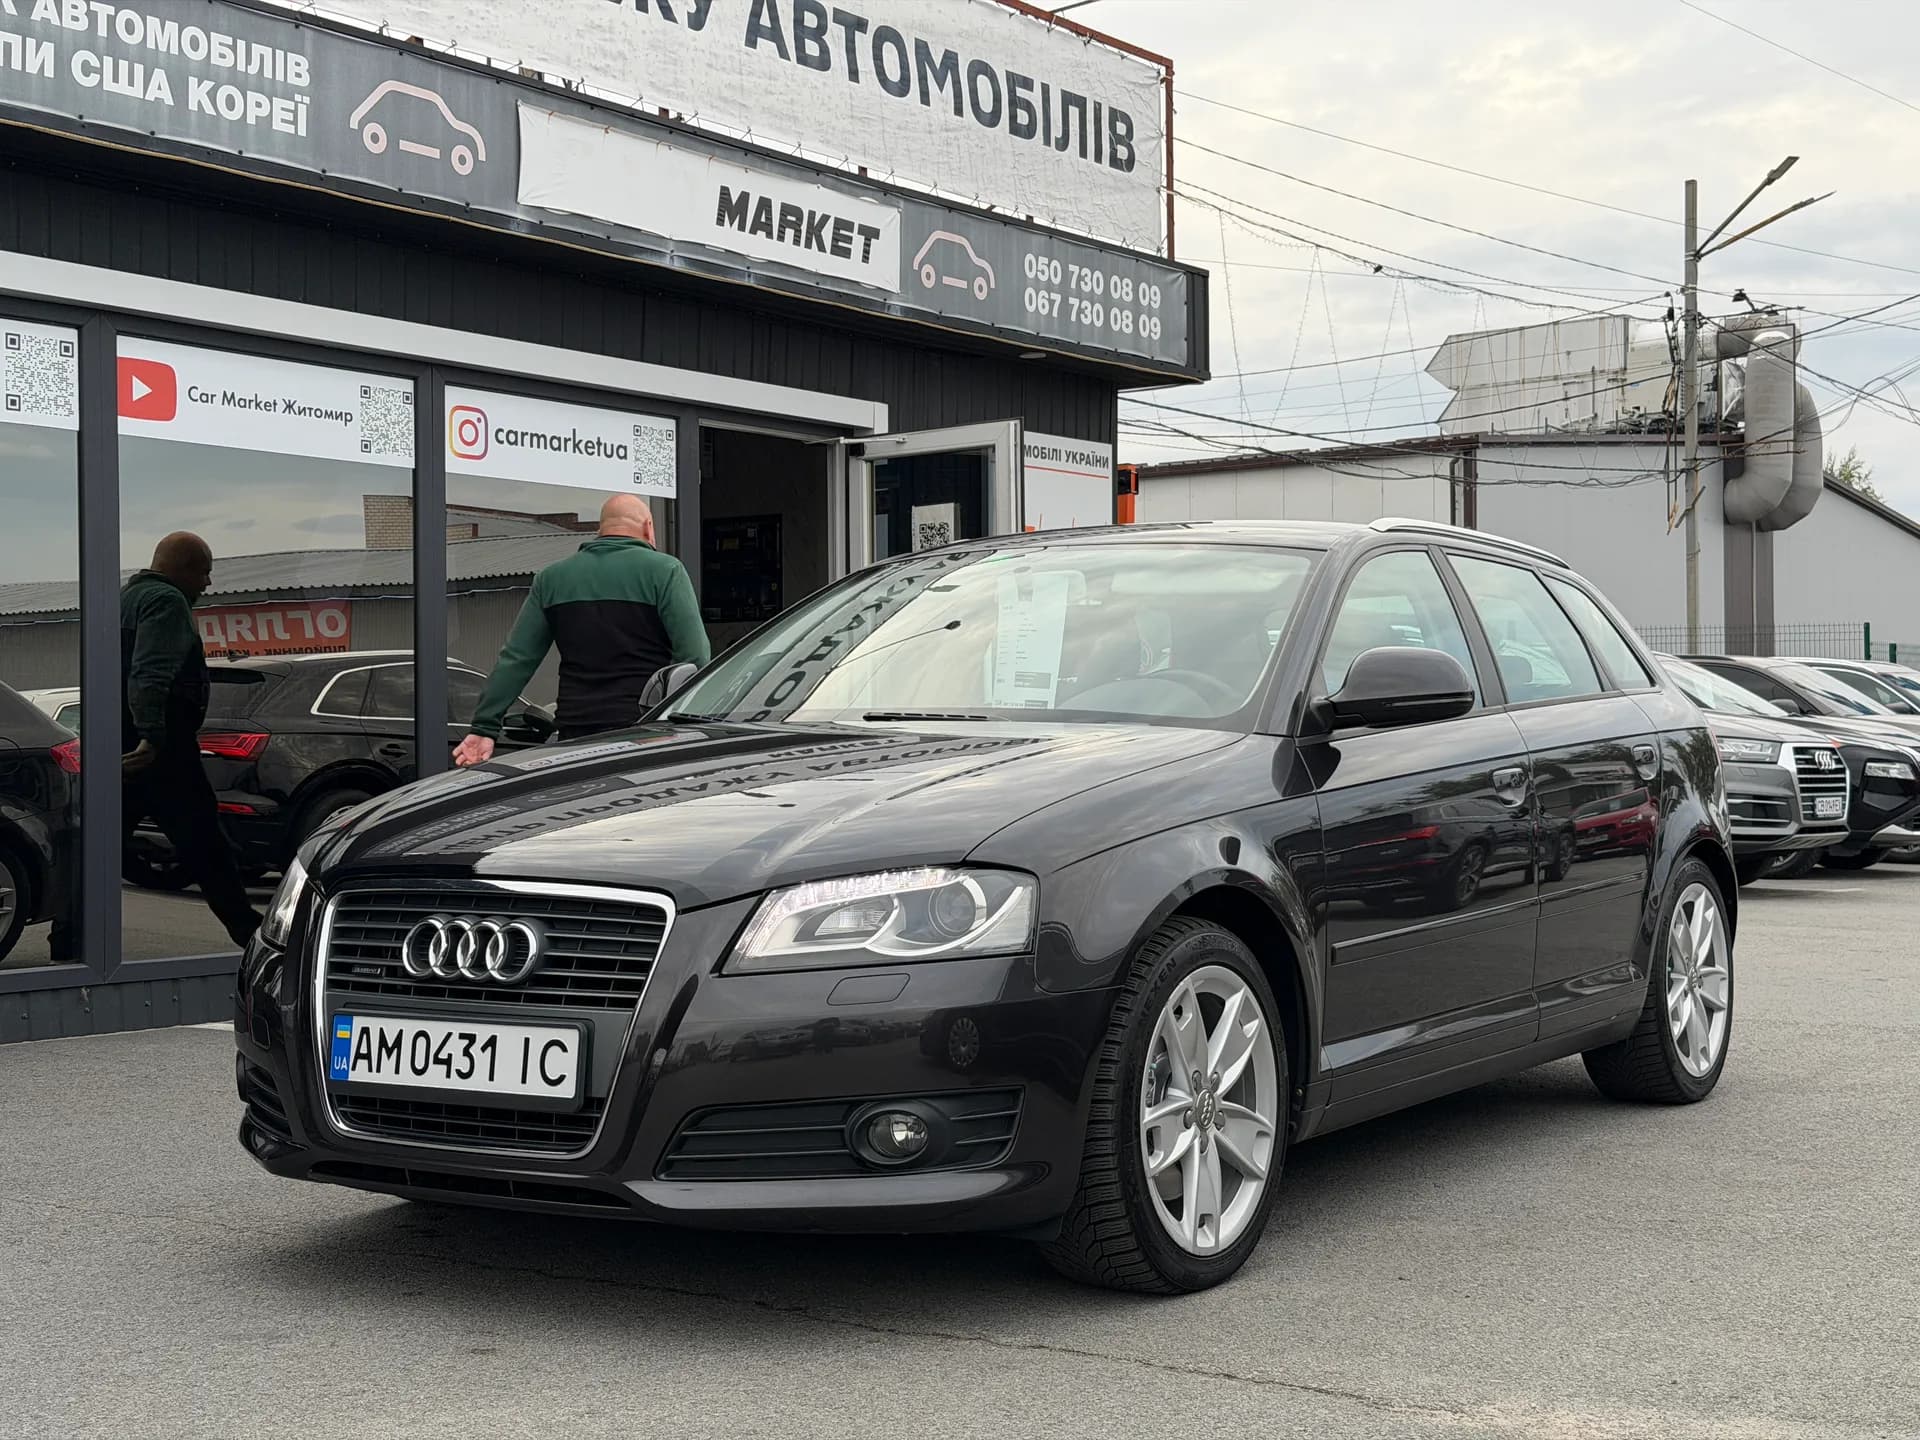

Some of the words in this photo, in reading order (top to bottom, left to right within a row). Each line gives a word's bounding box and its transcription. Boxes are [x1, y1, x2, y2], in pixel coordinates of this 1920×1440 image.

[31, 0, 311, 87] АВТОМОБІЛІВ
[71, 50, 175, 106] США
[188, 75, 311, 137] КОРЕЇ
[745, 0, 1136, 173] АВТОМОБІЛІВ
[716, 185, 881, 264] MARKET
[1024, 253, 1062, 285] 050
[1068, 264, 1104, 295] 730
[1110, 275, 1133, 302] 08
[1138, 282, 1161, 309] 09
[1024, 287, 1062, 318] 067
[1068, 297, 1104, 327] 730
[1110, 307, 1133, 334] 08
[1138, 314, 1161, 340] 09
[188, 385, 216, 404] Car
[221, 390, 278, 413] Market
[282, 398, 353, 426] Житомир
[494, 428, 628, 460] carmarketua
[1065, 449, 1109, 469] УКРАЇНИ
[334, 1056, 348, 1071] UA
